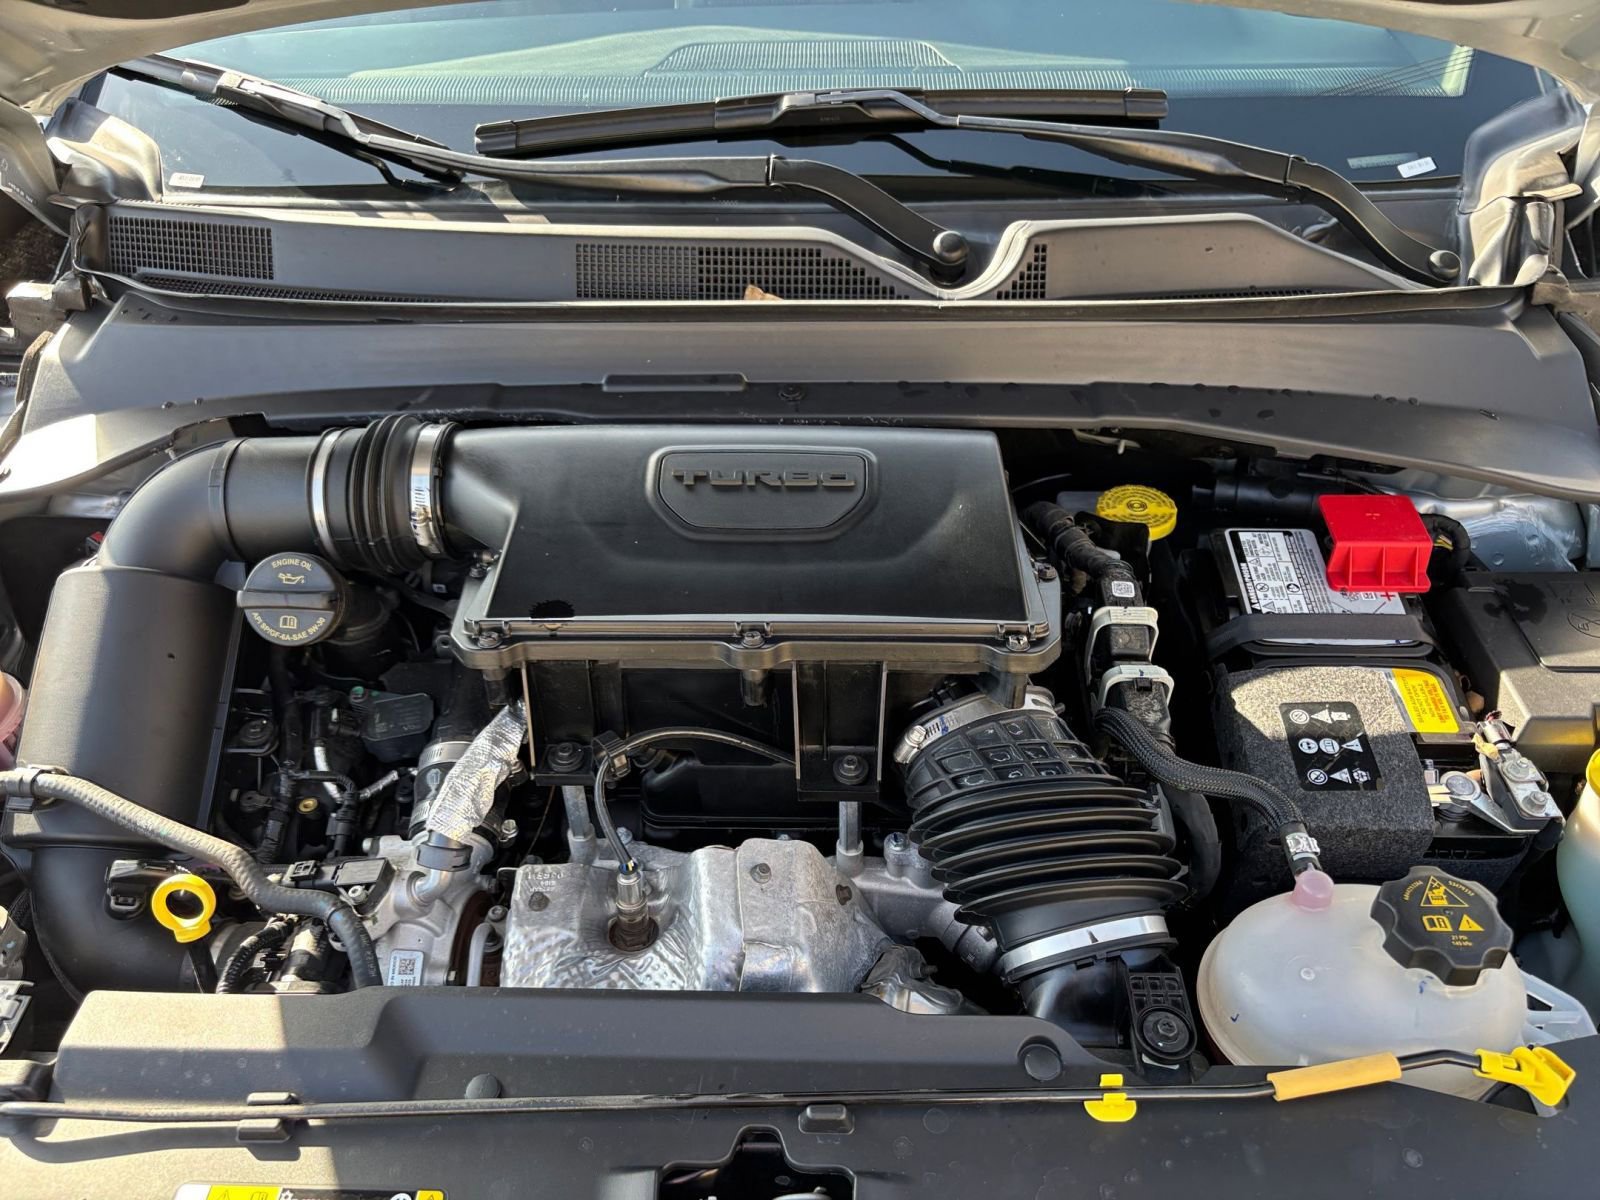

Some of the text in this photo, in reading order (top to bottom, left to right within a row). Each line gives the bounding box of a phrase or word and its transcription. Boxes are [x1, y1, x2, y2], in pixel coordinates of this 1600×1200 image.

[672, 470, 856, 487] TURBO
[271, 558, 313, 571] ENGINE OIL
[252, 612, 263, 625] API
